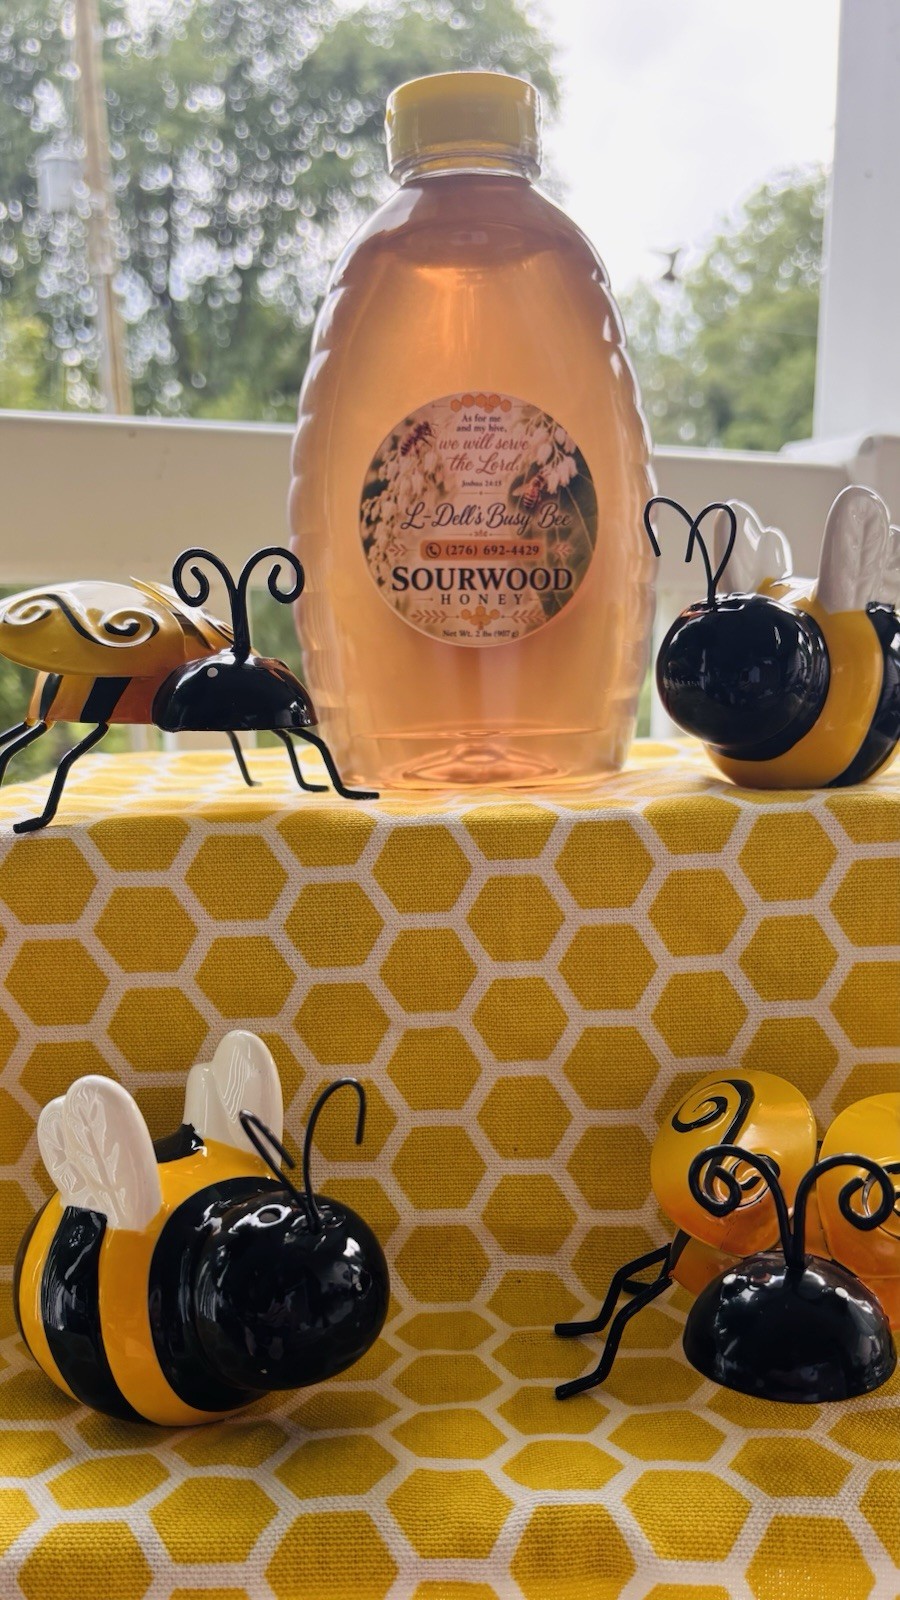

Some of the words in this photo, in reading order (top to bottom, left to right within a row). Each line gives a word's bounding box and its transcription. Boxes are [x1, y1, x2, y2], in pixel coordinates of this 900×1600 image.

[462, 415, 472, 423] As
[474, 414, 487, 422] for
[456, 424, 471, 432] and
[474, 426, 485, 434] my
[439, 439, 461, 450] we
[463, 433, 494, 450] will
[496, 438, 529, 450] serve
[447, 453, 474, 471] the
[461, 480, 483, 488] Joshua
[486, 503, 530, 535] Busy
[537, 502, 572, 529] Bee
[445, 544, 478, 557] (276)
[483, 545, 540, 556] 692-4429
[391, 566, 573, 591] SOURWOOD
[442, 629, 457, 637] Net
[459, 629, 473, 637] Wt.
